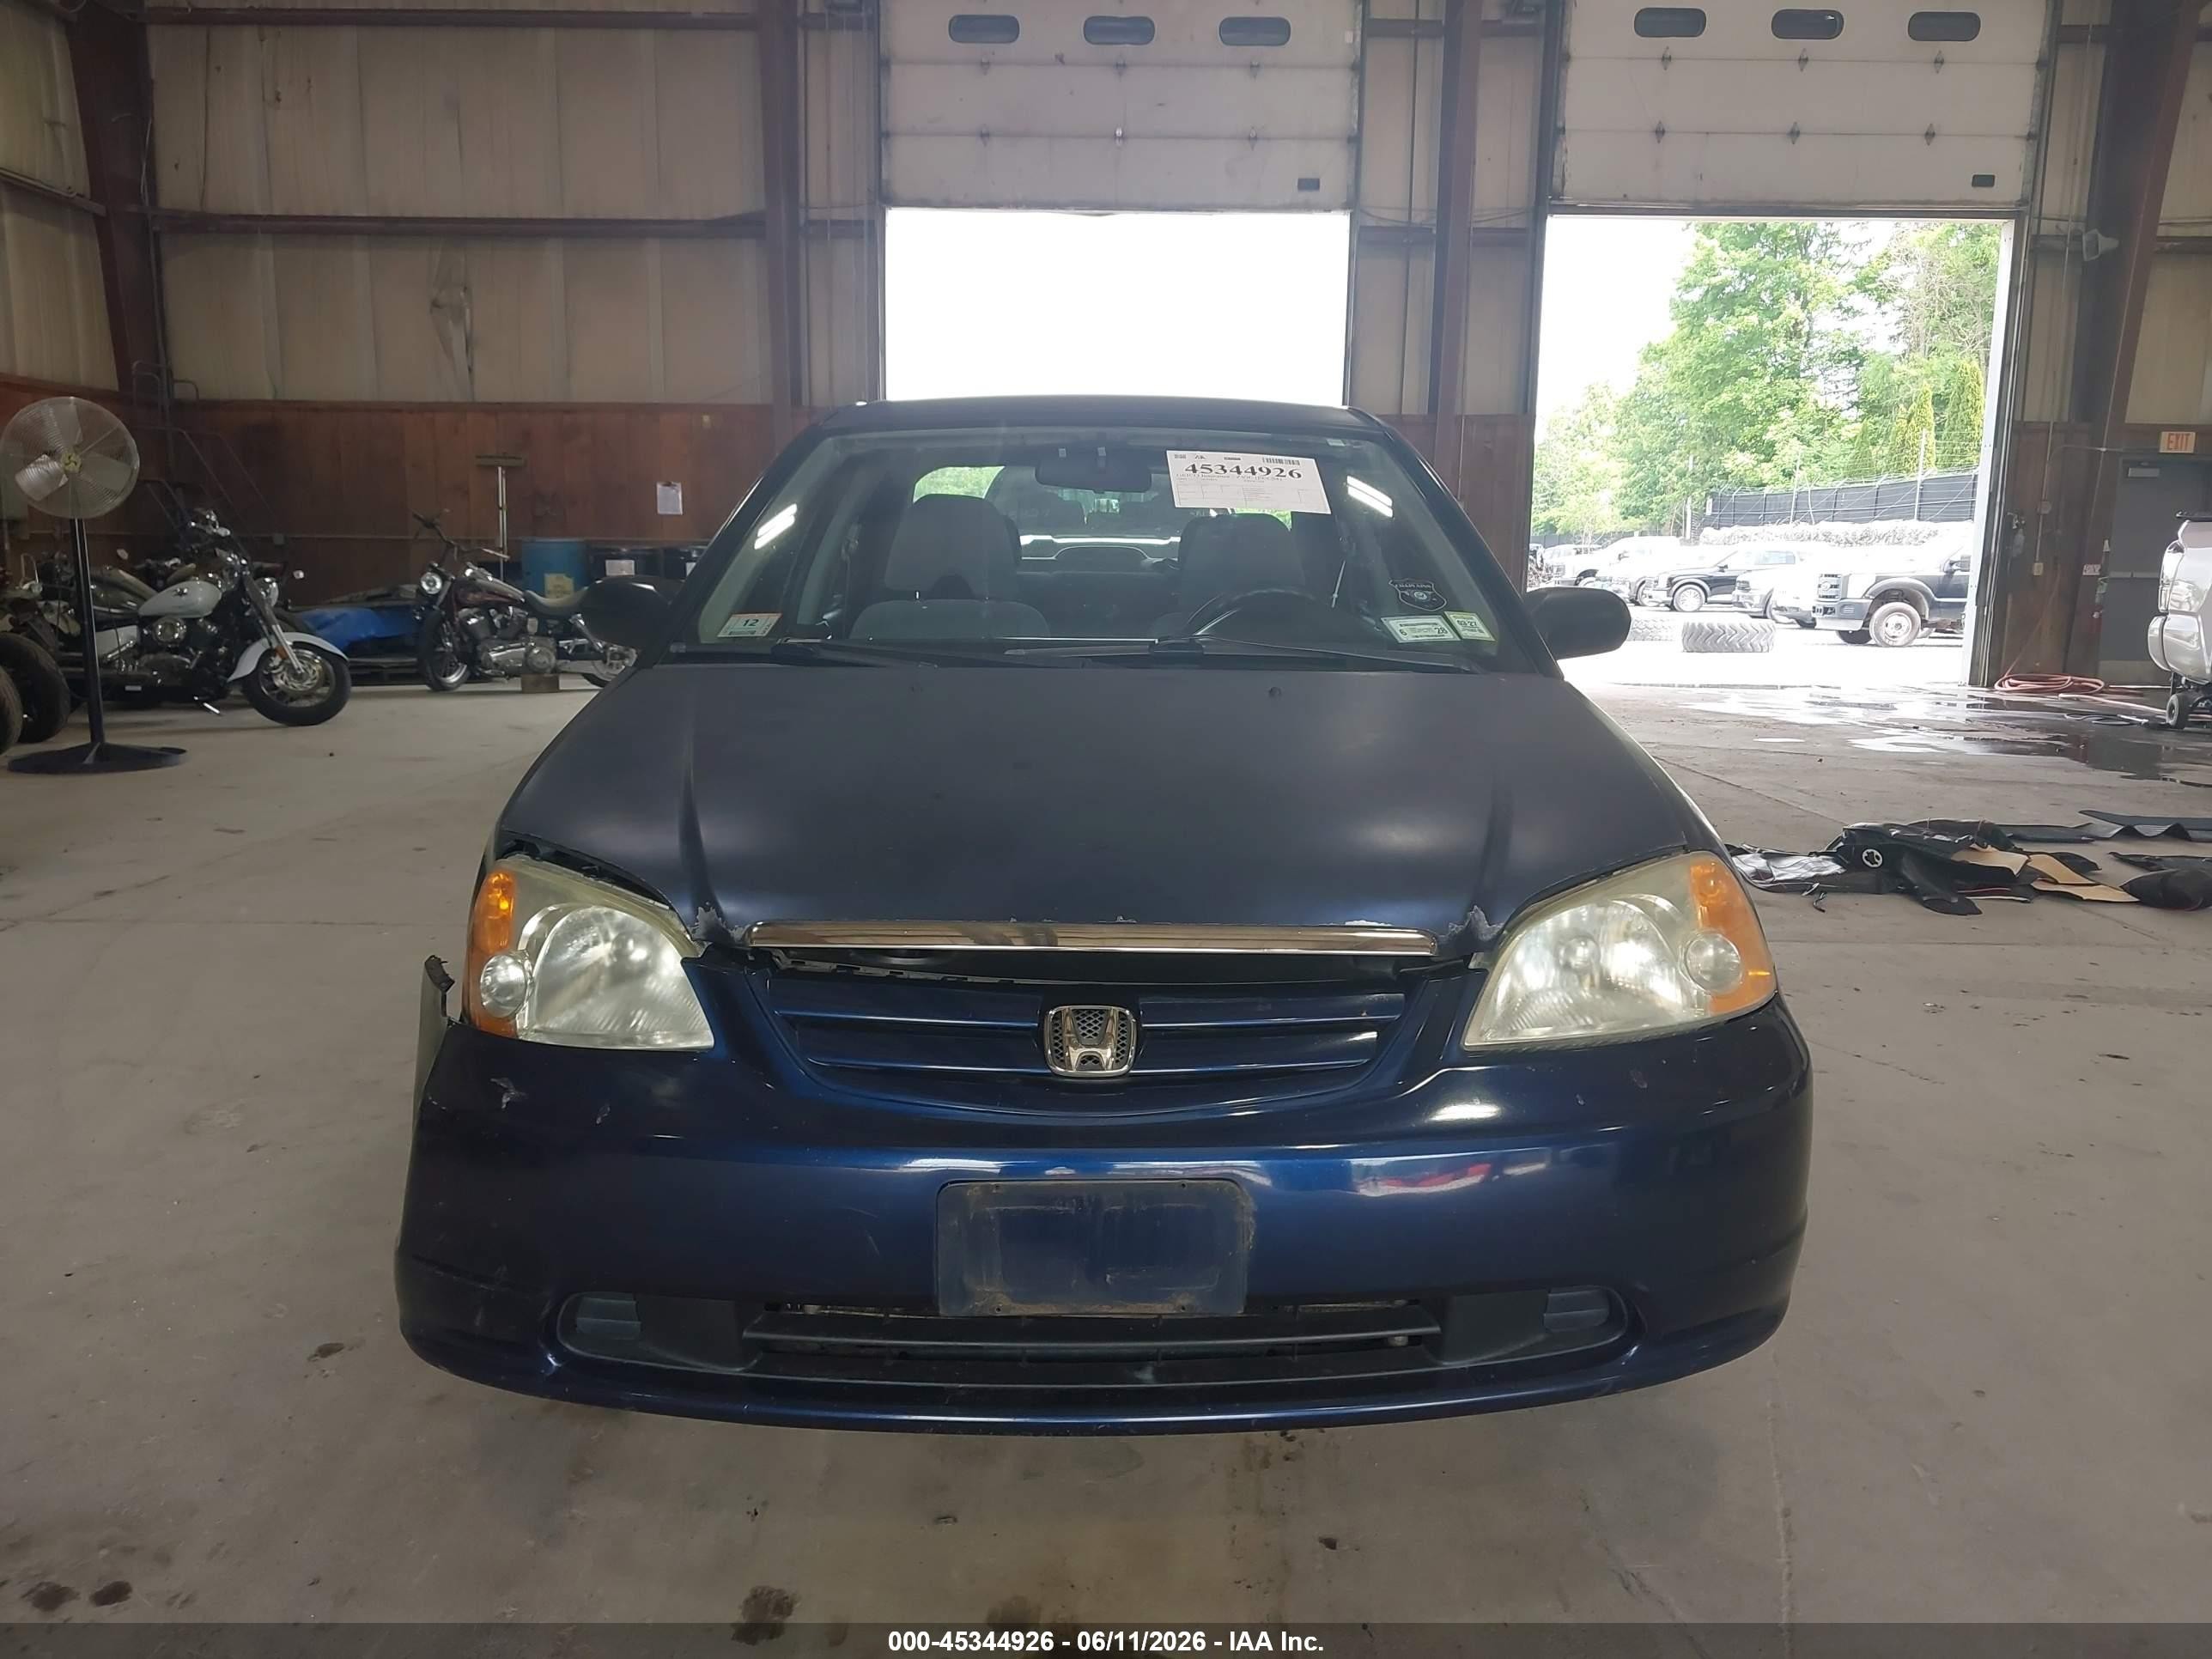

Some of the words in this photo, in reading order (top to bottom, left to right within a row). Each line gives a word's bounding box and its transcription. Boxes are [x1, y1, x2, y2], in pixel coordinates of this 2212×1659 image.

[2166, 432, 2191, 451] EXIT
[1184, 463, 1303, 479] 45344926
[742, 618, 760, 627] 12
